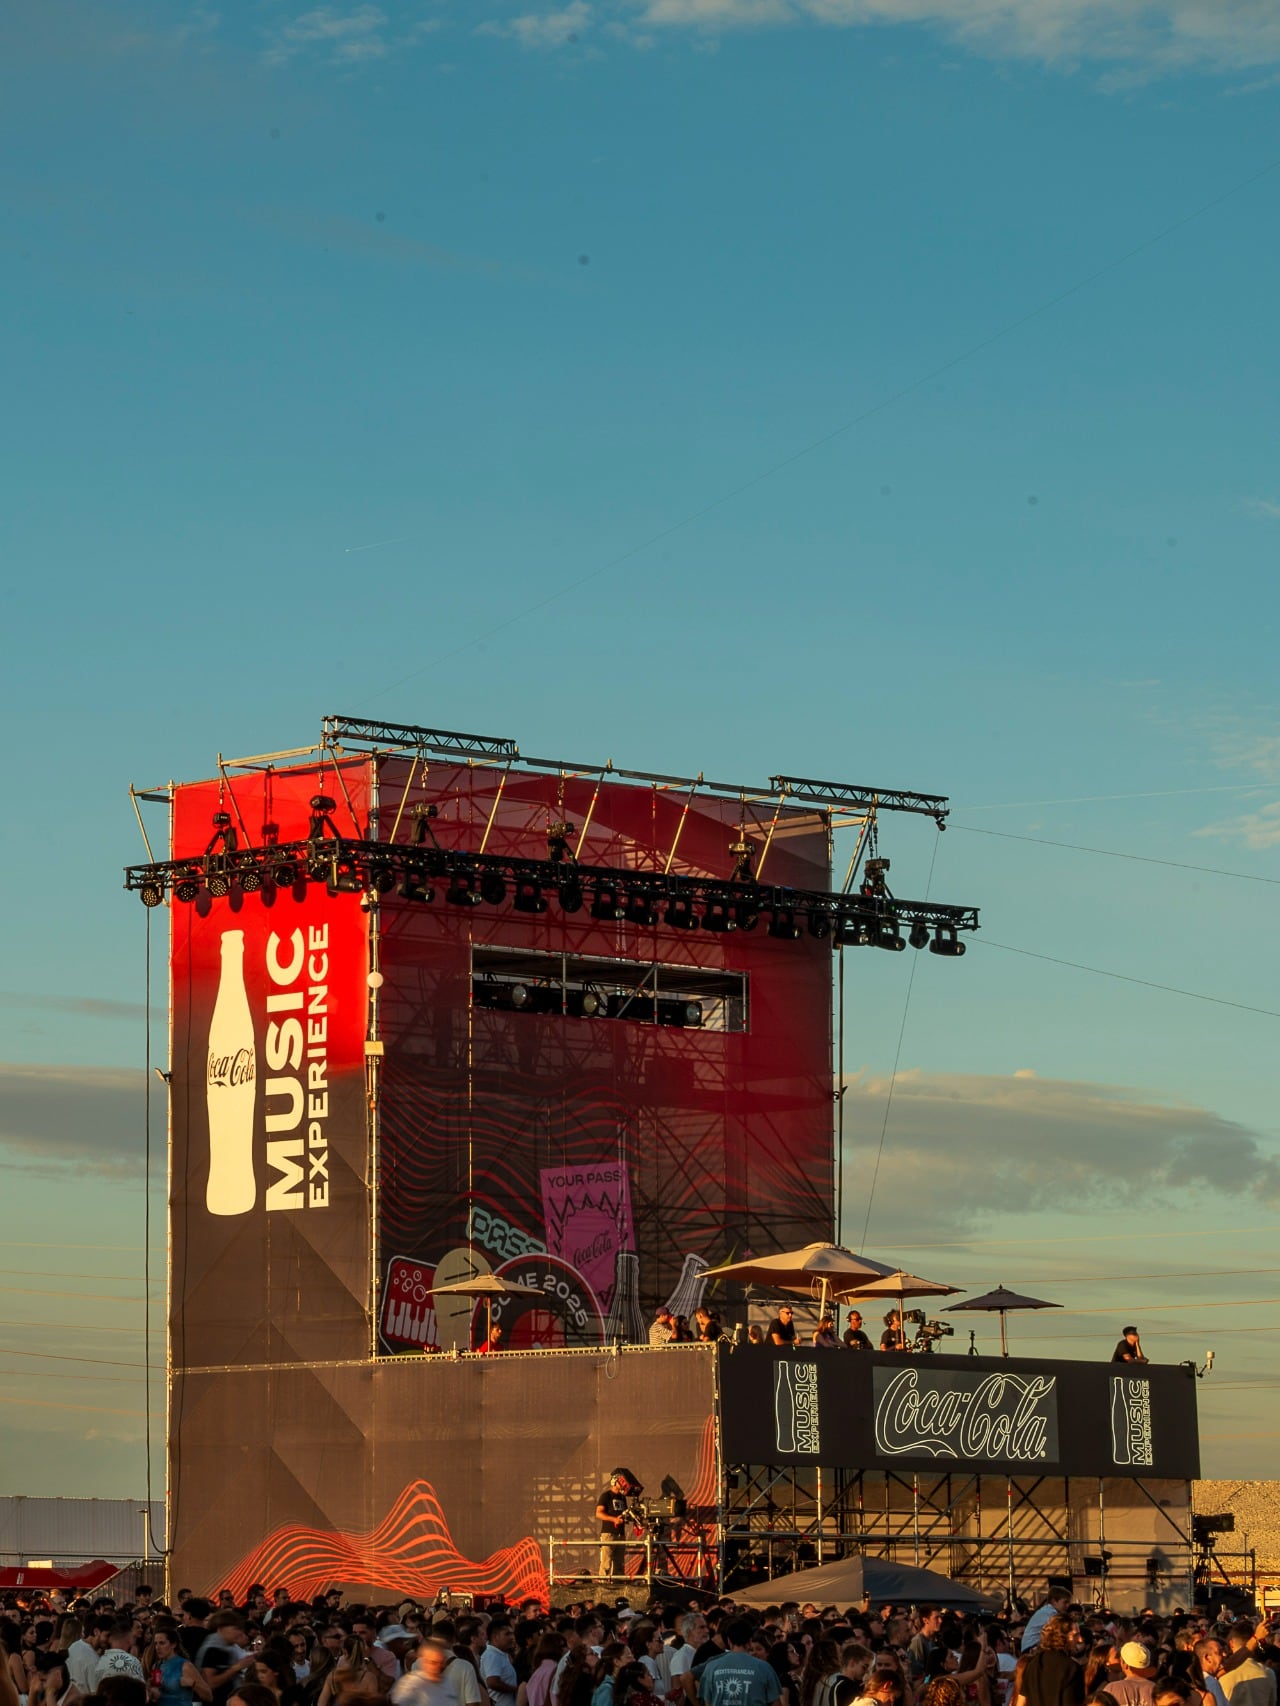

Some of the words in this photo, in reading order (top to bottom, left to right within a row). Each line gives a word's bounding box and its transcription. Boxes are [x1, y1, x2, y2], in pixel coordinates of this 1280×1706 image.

[207, 1048, 255, 1087] Coca-Cola
[265, 927, 305, 1212] MUSIC
[308, 923, 329, 1210] EXPERIENCE
[548, 1174, 584, 1188] YOUR
[587, 1170, 622, 1184] PASS
[543, 1274, 589, 1328] 2025
[795, 1363, 812, 1454] MUSIC
[808, 1363, 820, 1454] EXPERIENCE
[875, 1368, 1056, 1460] Coca-Cola
[1129, 1379, 1146, 1465] MUSIC
[1141, 1379, 1153, 1466] EXPERIENCE
